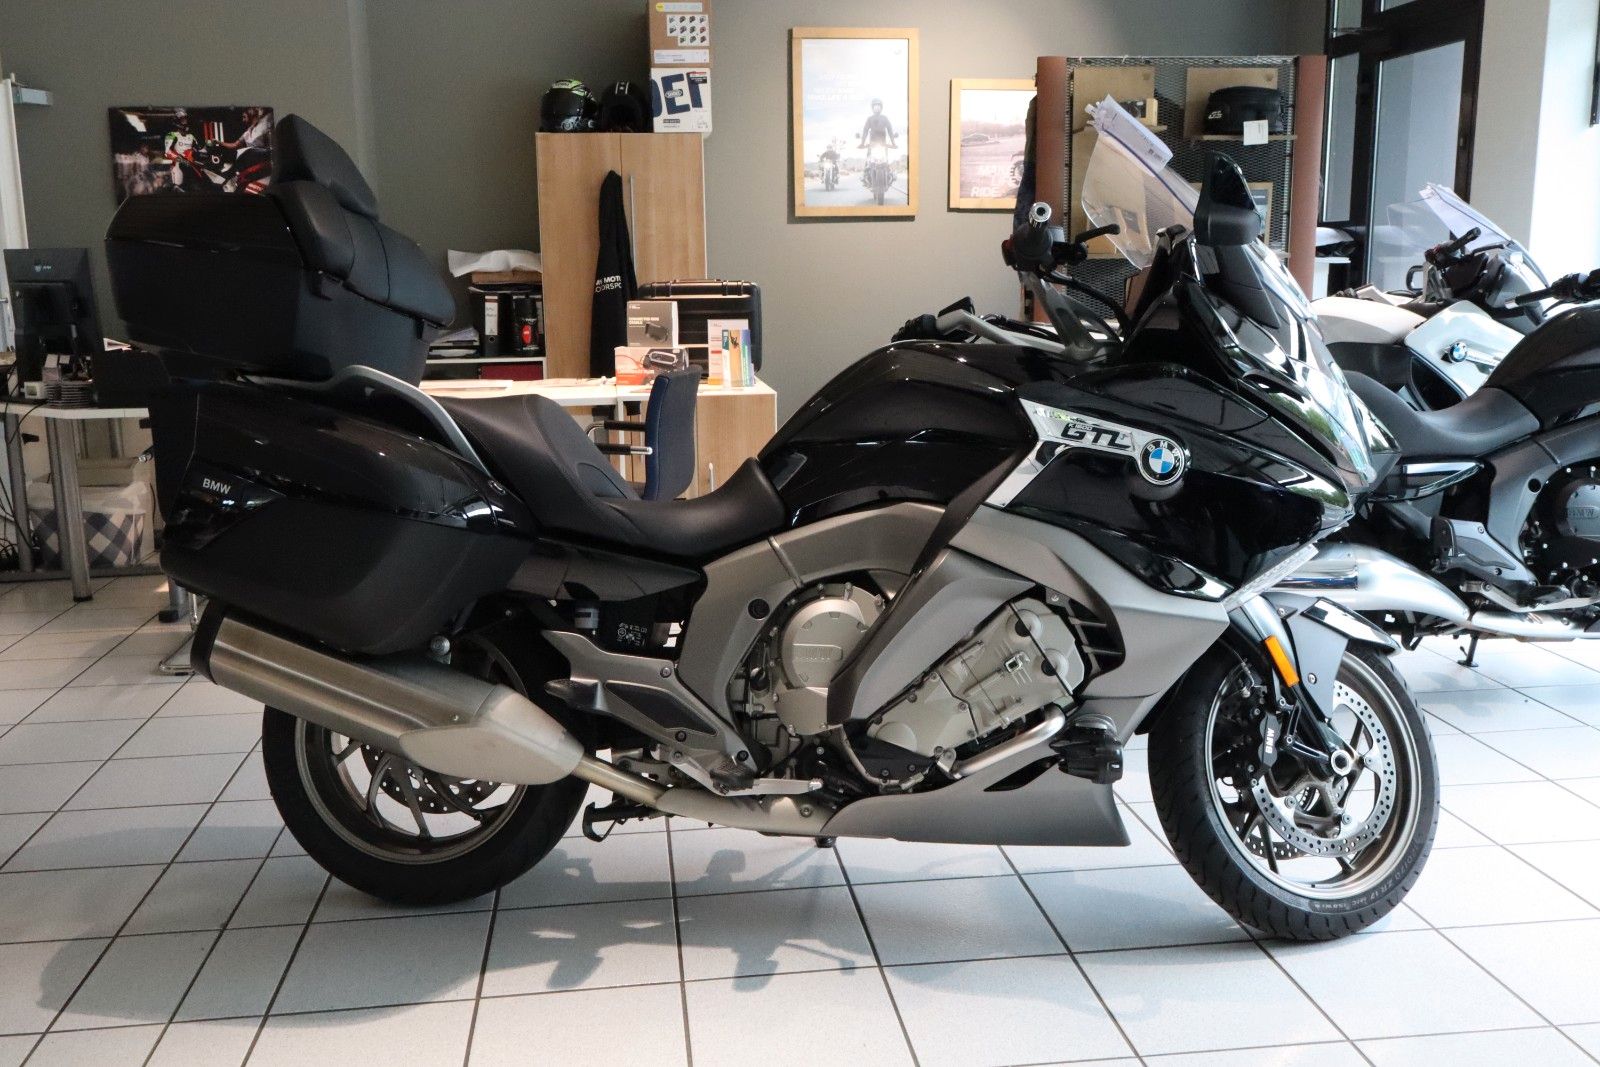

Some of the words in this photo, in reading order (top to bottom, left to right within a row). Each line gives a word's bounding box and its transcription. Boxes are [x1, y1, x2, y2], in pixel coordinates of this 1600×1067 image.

[1061, 422, 1131, 449] GTL
[203, 478, 231, 494] BMW
[1265, 727, 1274, 753] BMW
